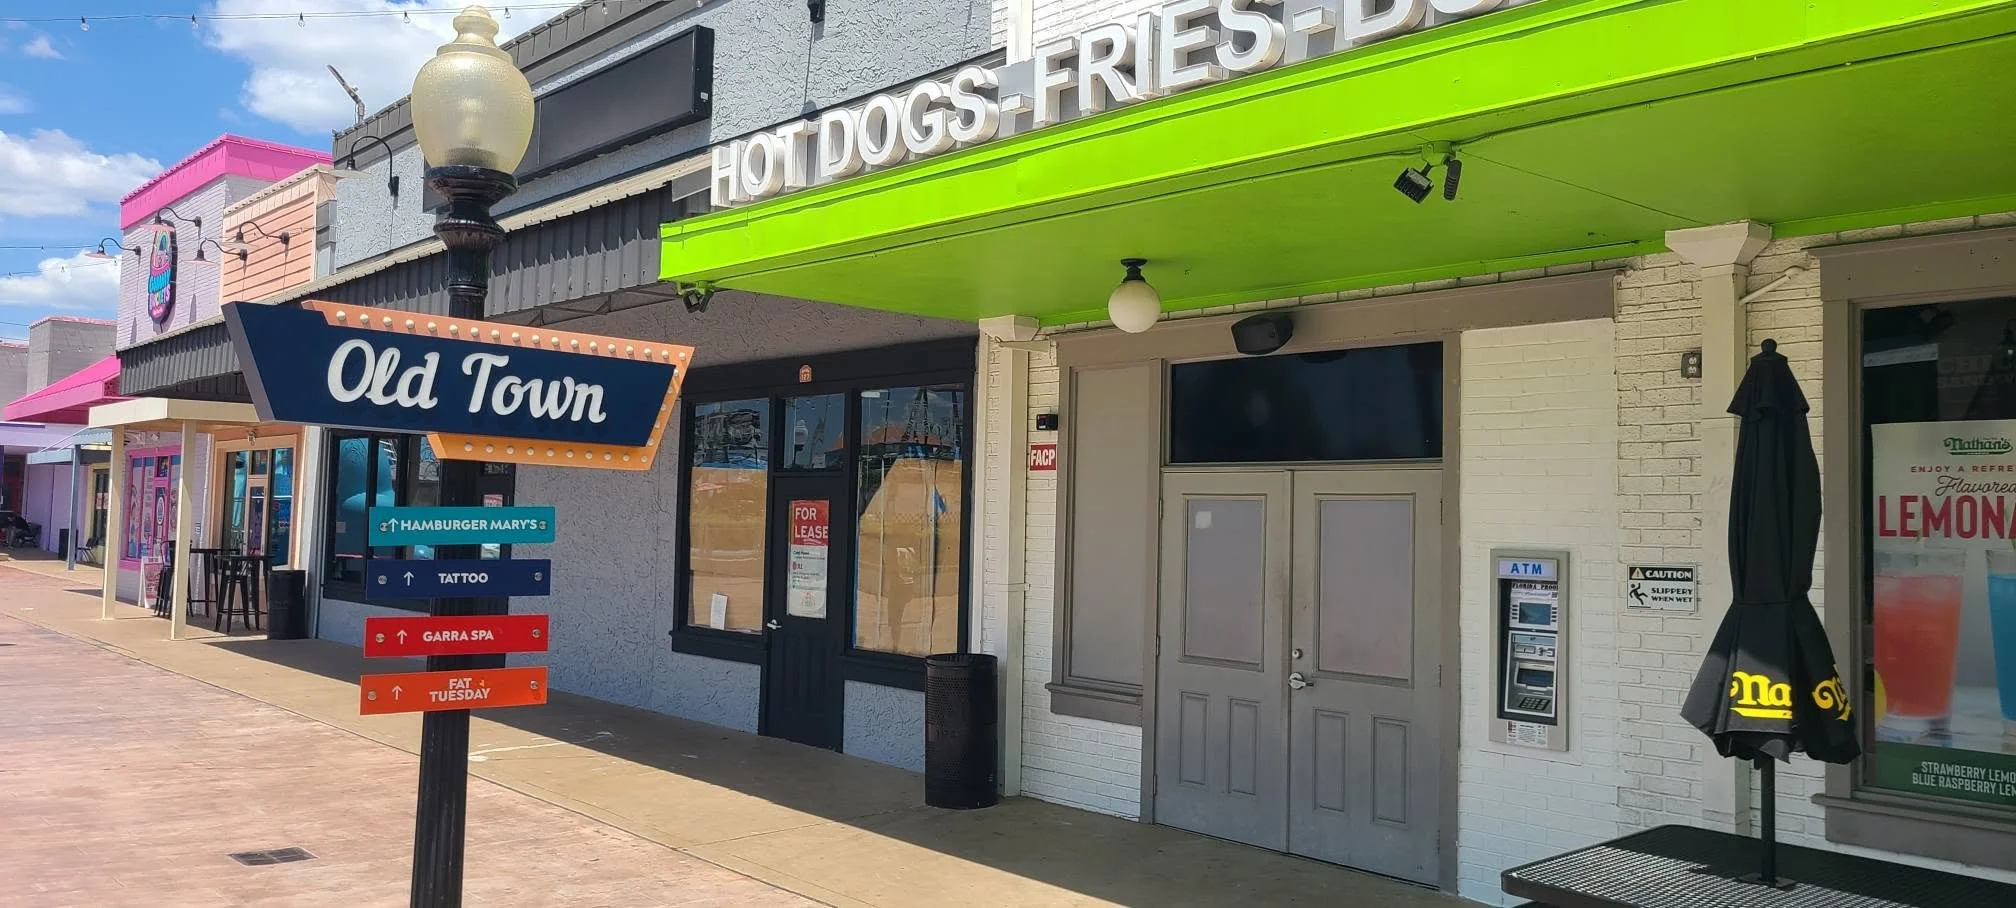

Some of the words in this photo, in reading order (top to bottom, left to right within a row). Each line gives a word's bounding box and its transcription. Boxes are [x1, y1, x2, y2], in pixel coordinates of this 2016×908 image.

[711, 117, 819, 207] HOT
[327, 338, 441, 410] Old
[461, 352, 607, 424] Town
[1943, 437, 2013, 452] Nathan's
[1030, 448, 1056, 466] FACP
[1910, 465, 1950, 473] ENJOY
[795, 507, 817, 521] FOR
[400, 519, 488, 531] HAMBURGER
[490, 519, 538, 530] MARY'S
[794, 525, 829, 540] LEASE
[1510, 562, 1542, 575] ATM
[1645, 569, 1692, 579] CAUTION
[438, 572, 489, 584] TATTOO
[422, 630, 469, 642] GARRA
[470, 629, 494, 641] SPA
[449, 677, 472, 690] FAT
[429, 687, 491, 703] TUESDAY
[1921, 761, 1986, 780] STRAWBERRY
[1912, 772, 1937, 787] BLUE
[1938, 775, 1996, 795] RASPBERRY
